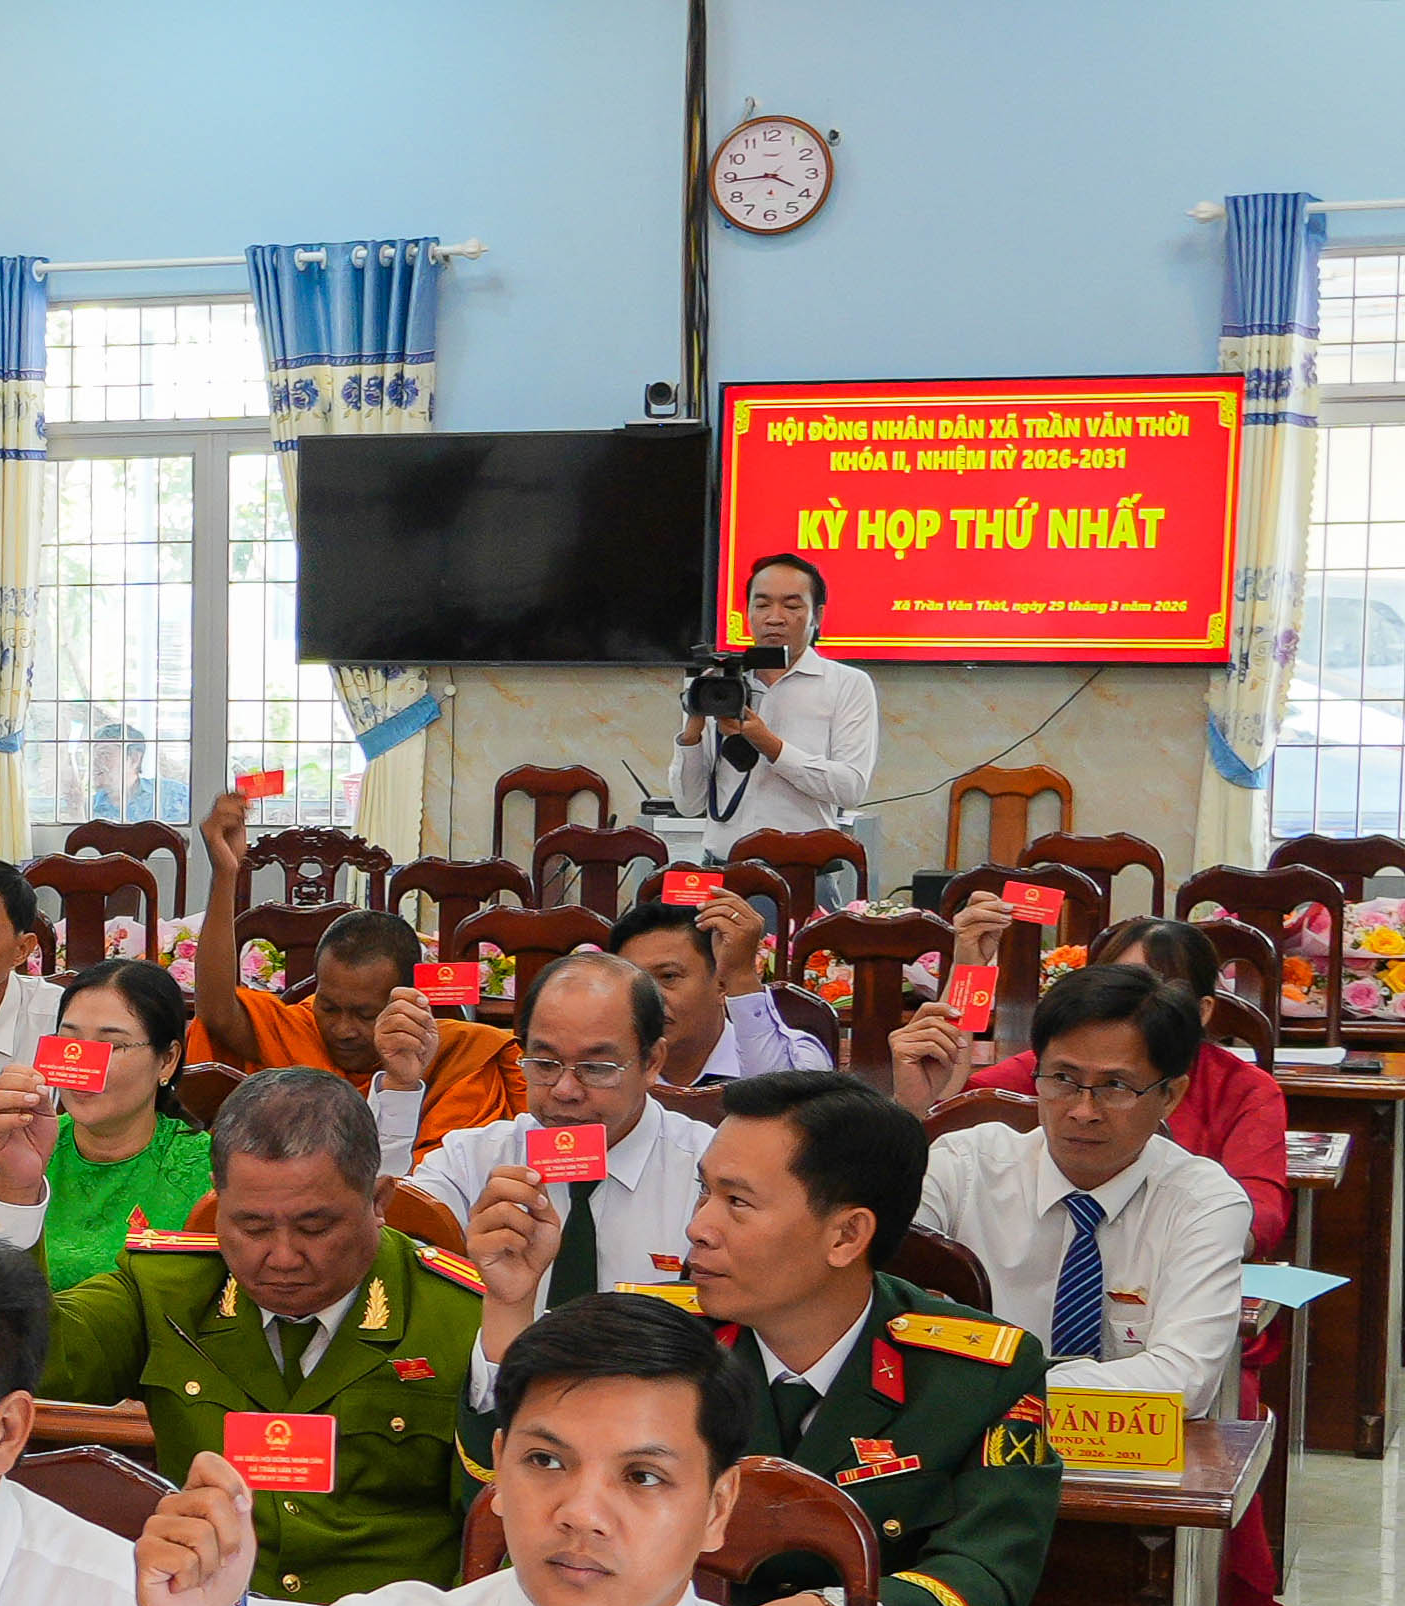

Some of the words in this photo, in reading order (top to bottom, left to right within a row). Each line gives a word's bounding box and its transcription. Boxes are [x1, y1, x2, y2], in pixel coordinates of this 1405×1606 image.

[763, 130, 781, 142] 12
[744, 139, 756, 149] 11
[729, 153, 746, 165] 10
[799, 148, 813, 161] 2
[724, 172, 737, 183] 9
[805, 168, 819, 179] 3
[730, 191, 743, 203] 8
[798, 188, 812, 199] 4
[744, 204, 755, 216] 7
[785, 202, 799, 214] 5
[763, 210, 777, 221] 6
[767, 416, 804, 446] HỘI
[808, 414, 868, 441] ĐỒNG
[872, 415, 934, 440] NHÂN
[939, 413, 985, 439] DÂN
[989, 413, 1019, 439] XÃ
[1023, 411, 1080, 438] TRẦN
[1085, 411, 1132, 437] VĂN
[1136, 410, 1189, 437] THỜI
[830, 446, 888, 471] KHÓA
[892, 451, 911, 473] II,
[917, 444, 986, 475] NHIỆM
[990, 443, 1018, 469] KỲ
[1021, 448, 1126, 469] 2026-2031
[798, 497, 848, 550] KỲ
[858, 509, 940, 560] HỌP
[950, 497, 1040, 549] THỨ
[1048, 493, 1165, 549] NHẤT
[1048, 600, 1065, 611] 29
[1109, 601, 1119, 611] 3
[1154, 600, 1187, 611] 2026
[1047, 1404, 1099, 1433] VĂN
[1108, 1403, 1166, 1435] ĐẤU
